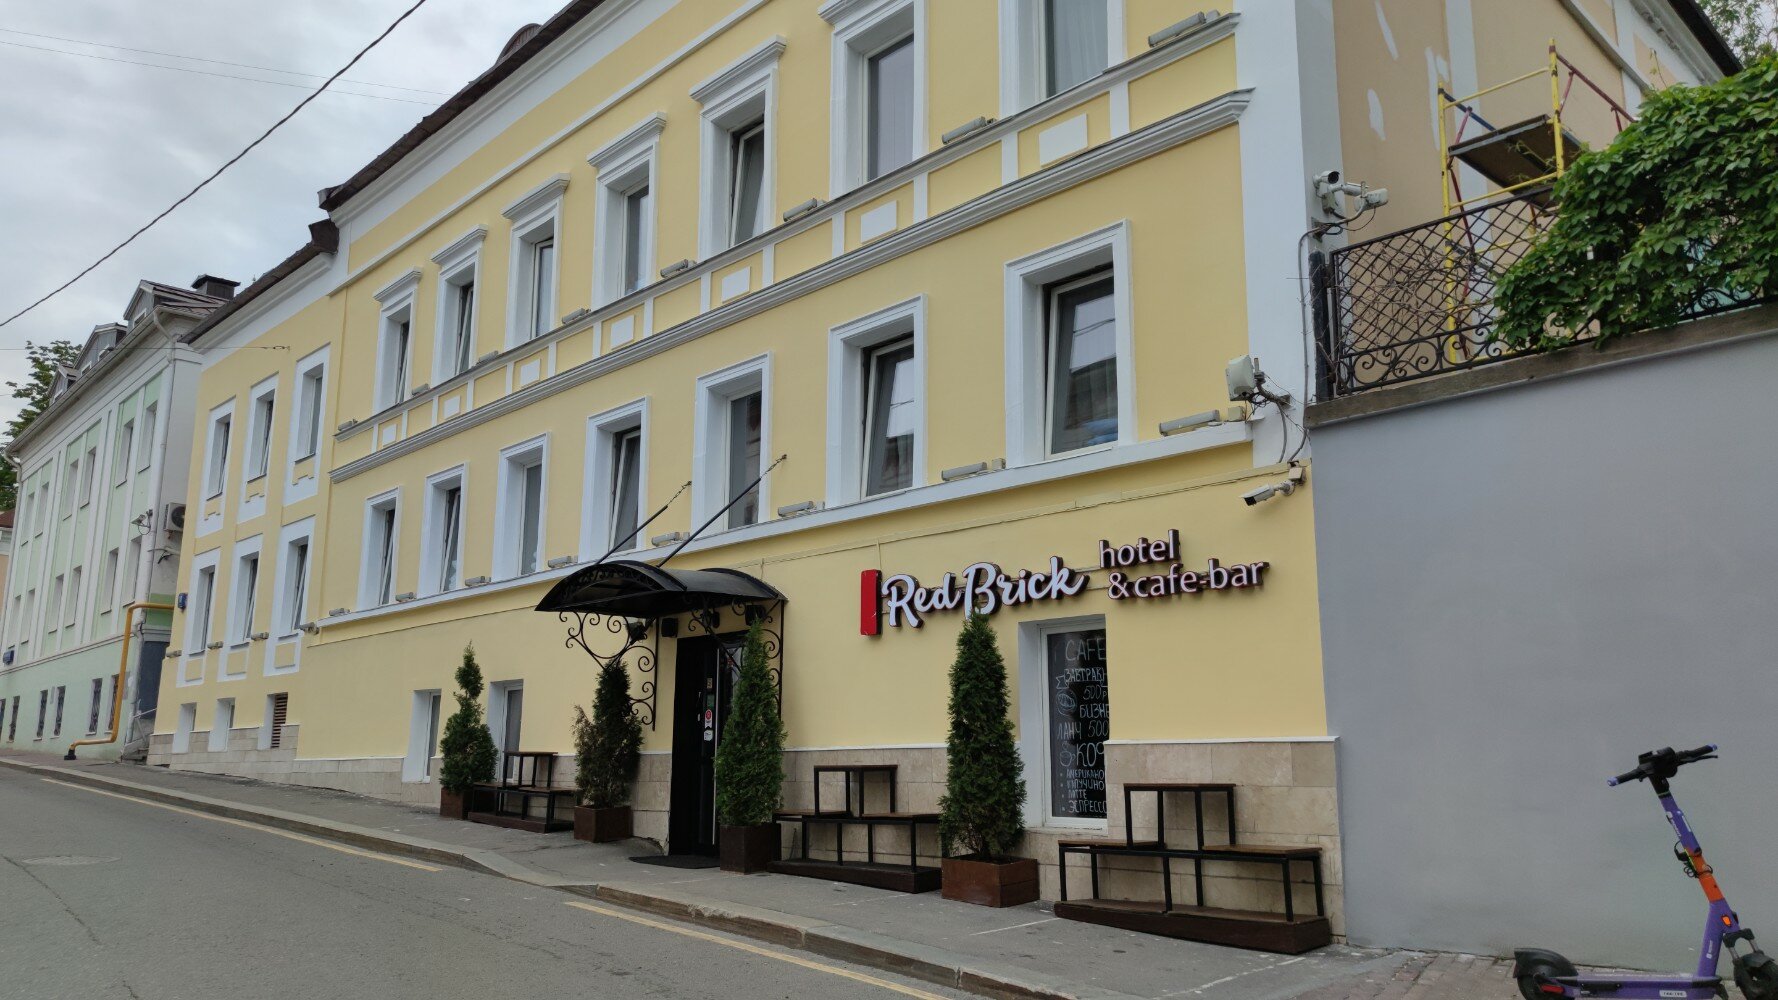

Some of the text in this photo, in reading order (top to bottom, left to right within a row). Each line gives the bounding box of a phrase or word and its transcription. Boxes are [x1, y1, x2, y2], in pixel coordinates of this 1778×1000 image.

[1099, 529, 1179, 568] hotel
[1065, 637, 1107, 661] CAFE
[1057, 721, 1082, 740] ЛАНЧ
